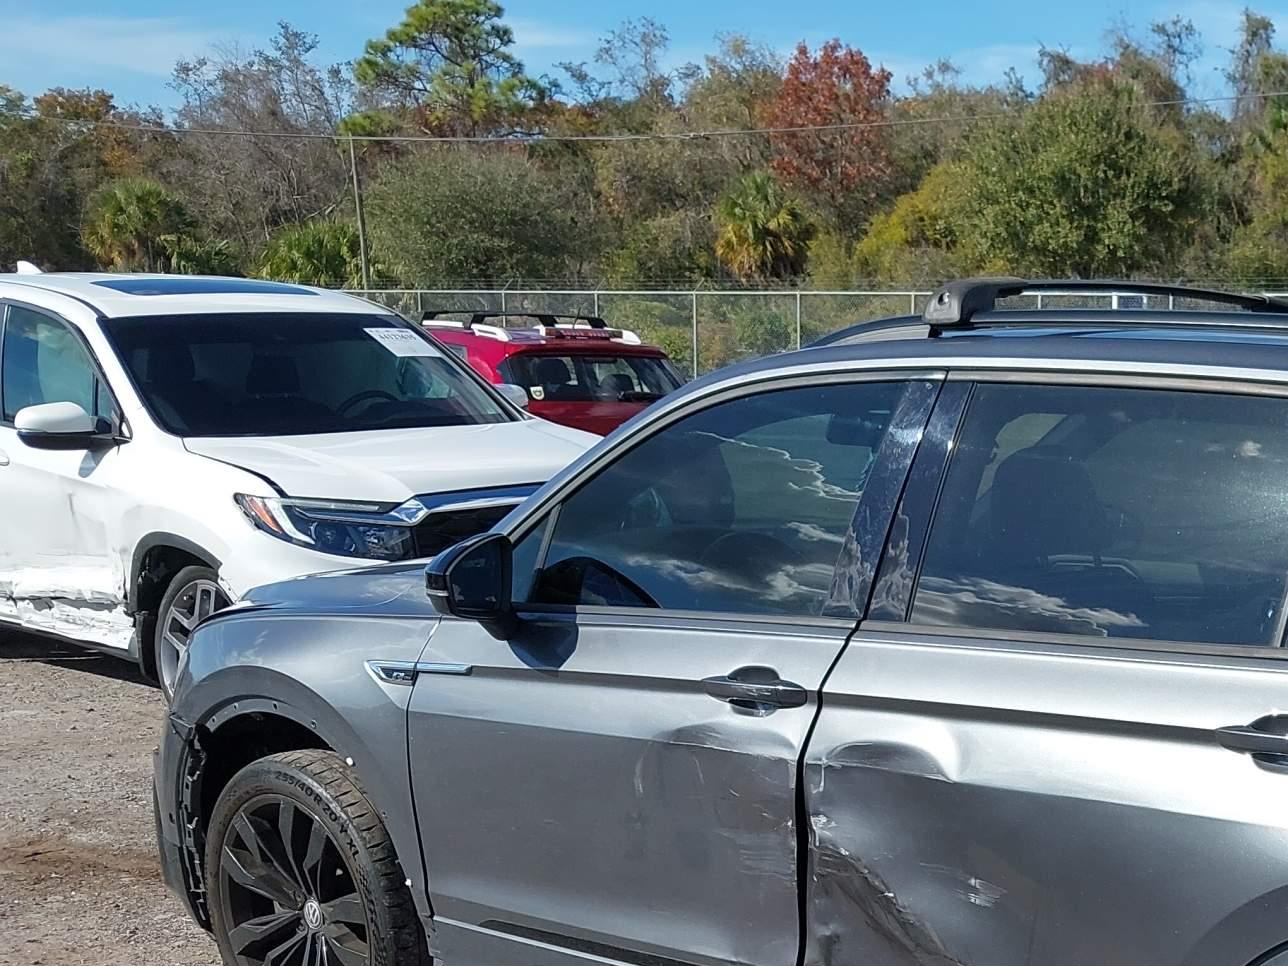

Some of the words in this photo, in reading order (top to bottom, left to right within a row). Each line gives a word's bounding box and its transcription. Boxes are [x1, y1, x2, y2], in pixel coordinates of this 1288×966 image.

[275, 770, 313, 797] 255/40
[313, 793, 323, 806] R
[322, 803, 338, 822] 20
[346, 838, 360, 862] XL
